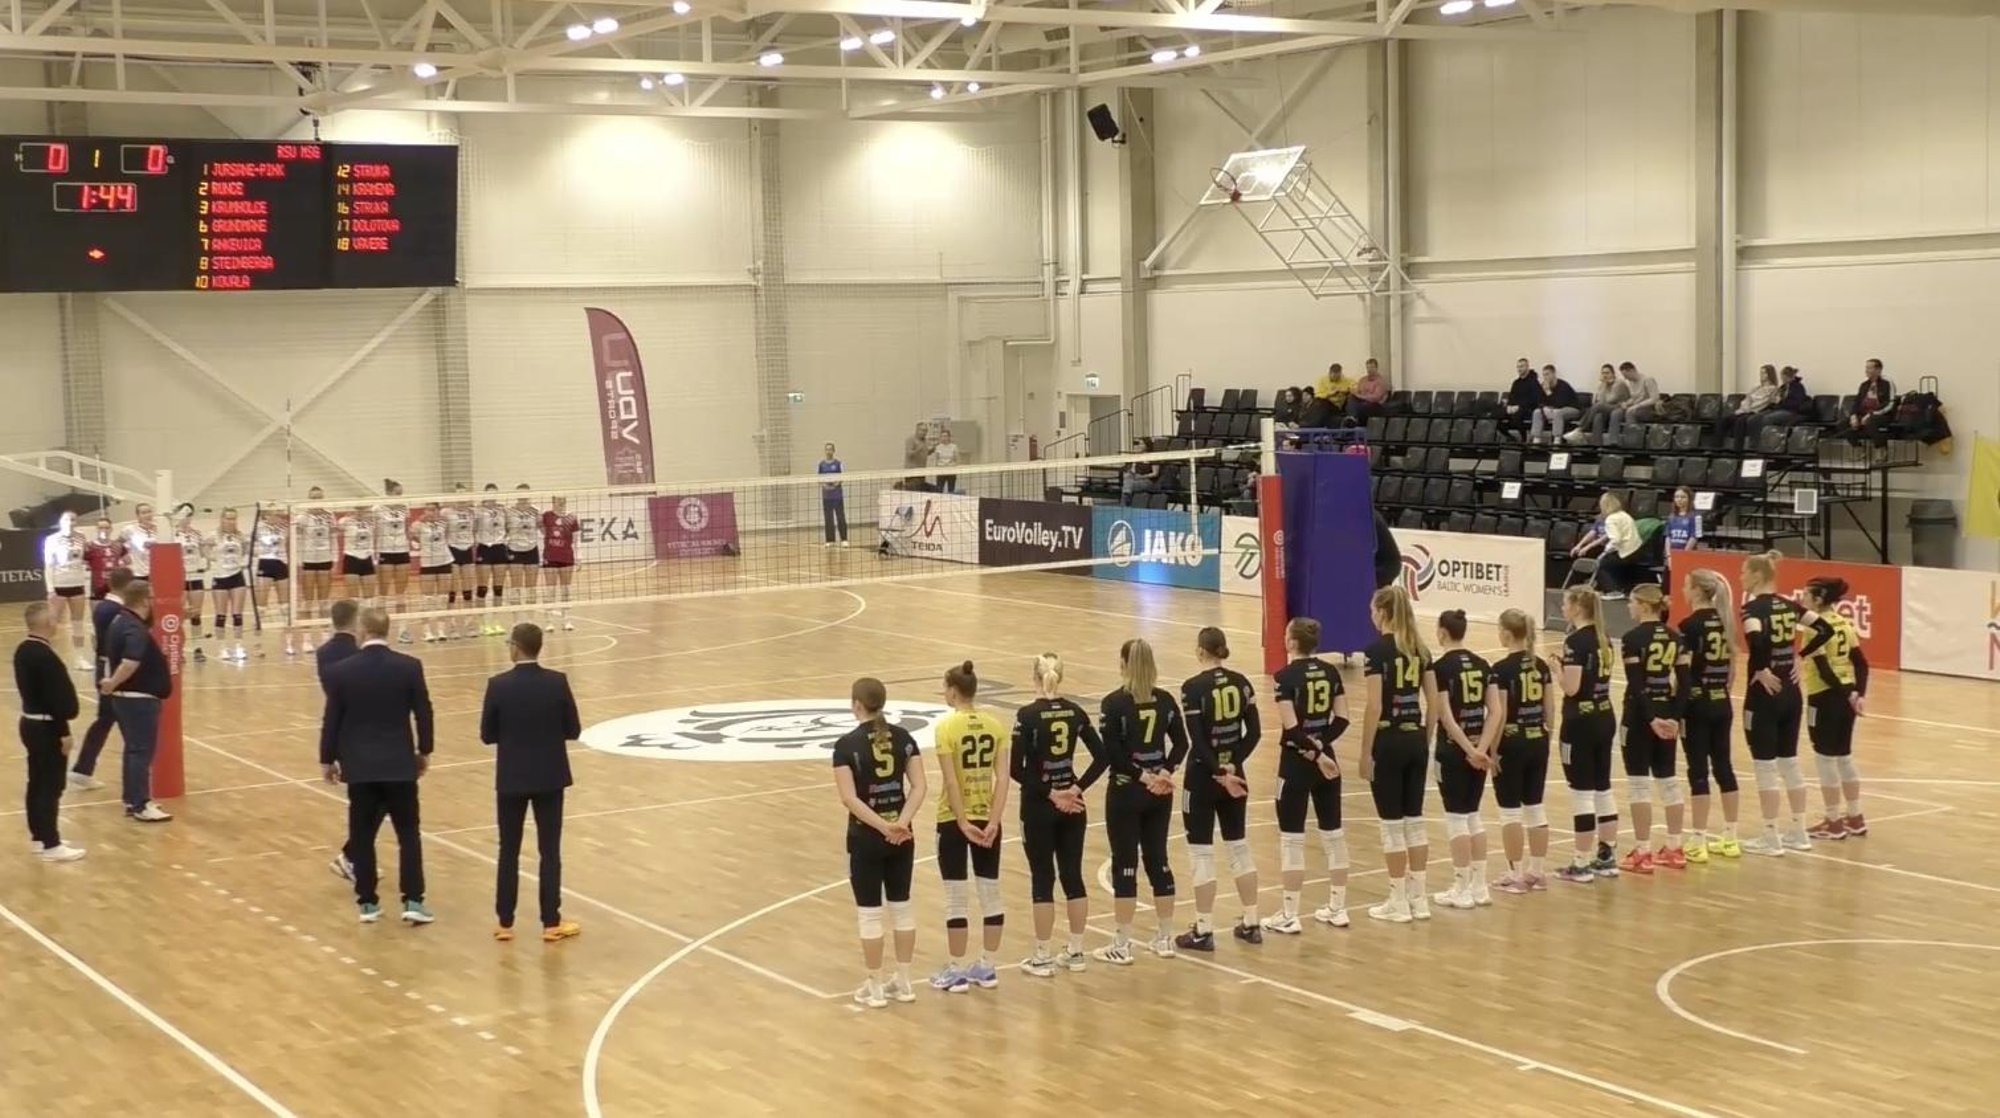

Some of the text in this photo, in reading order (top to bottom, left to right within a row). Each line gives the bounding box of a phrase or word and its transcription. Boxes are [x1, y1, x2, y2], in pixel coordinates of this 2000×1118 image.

[48, 143, 65, 171] 0
[94, 149, 100, 168] 1
[148, 145, 164, 172] 0
[277, 145, 298, 159] RSU
[337, 164, 350, 177] 12
[82, 185, 133, 209] 1:44
[199, 182, 208, 195] 2
[337, 182, 349, 195] 14
[199, 201, 208, 214] 3
[337, 201, 349, 214] 16
[199, 220, 208, 233] 6
[337, 219, 349, 232] 17
[200, 238, 209, 251] 7
[337, 237, 349, 250] 18
[196, 275, 208, 288] 10
[911, 541, 943, 551] TEIDA
[985, 519, 1084, 553] EuroVolley.TV
[1142, 529, 1204, 567] JAKO
[1438, 559, 1502, 582] OPTIBET
[1770, 613, 1797, 643] 55
[1646, 641, 1677, 671] 24
[1395, 656, 1420, 688] 14
[1307, 680, 1331, 714] 13
[1460, 670, 1483, 703] 15
[1520, 670, 1543, 703] 16
[1212, 685, 1240, 721] 10
[1050, 721, 1069, 755] 3
[1139, 709, 1157, 743] 7
[872, 740, 894, 777] 5
[961, 734, 995, 769] 22
